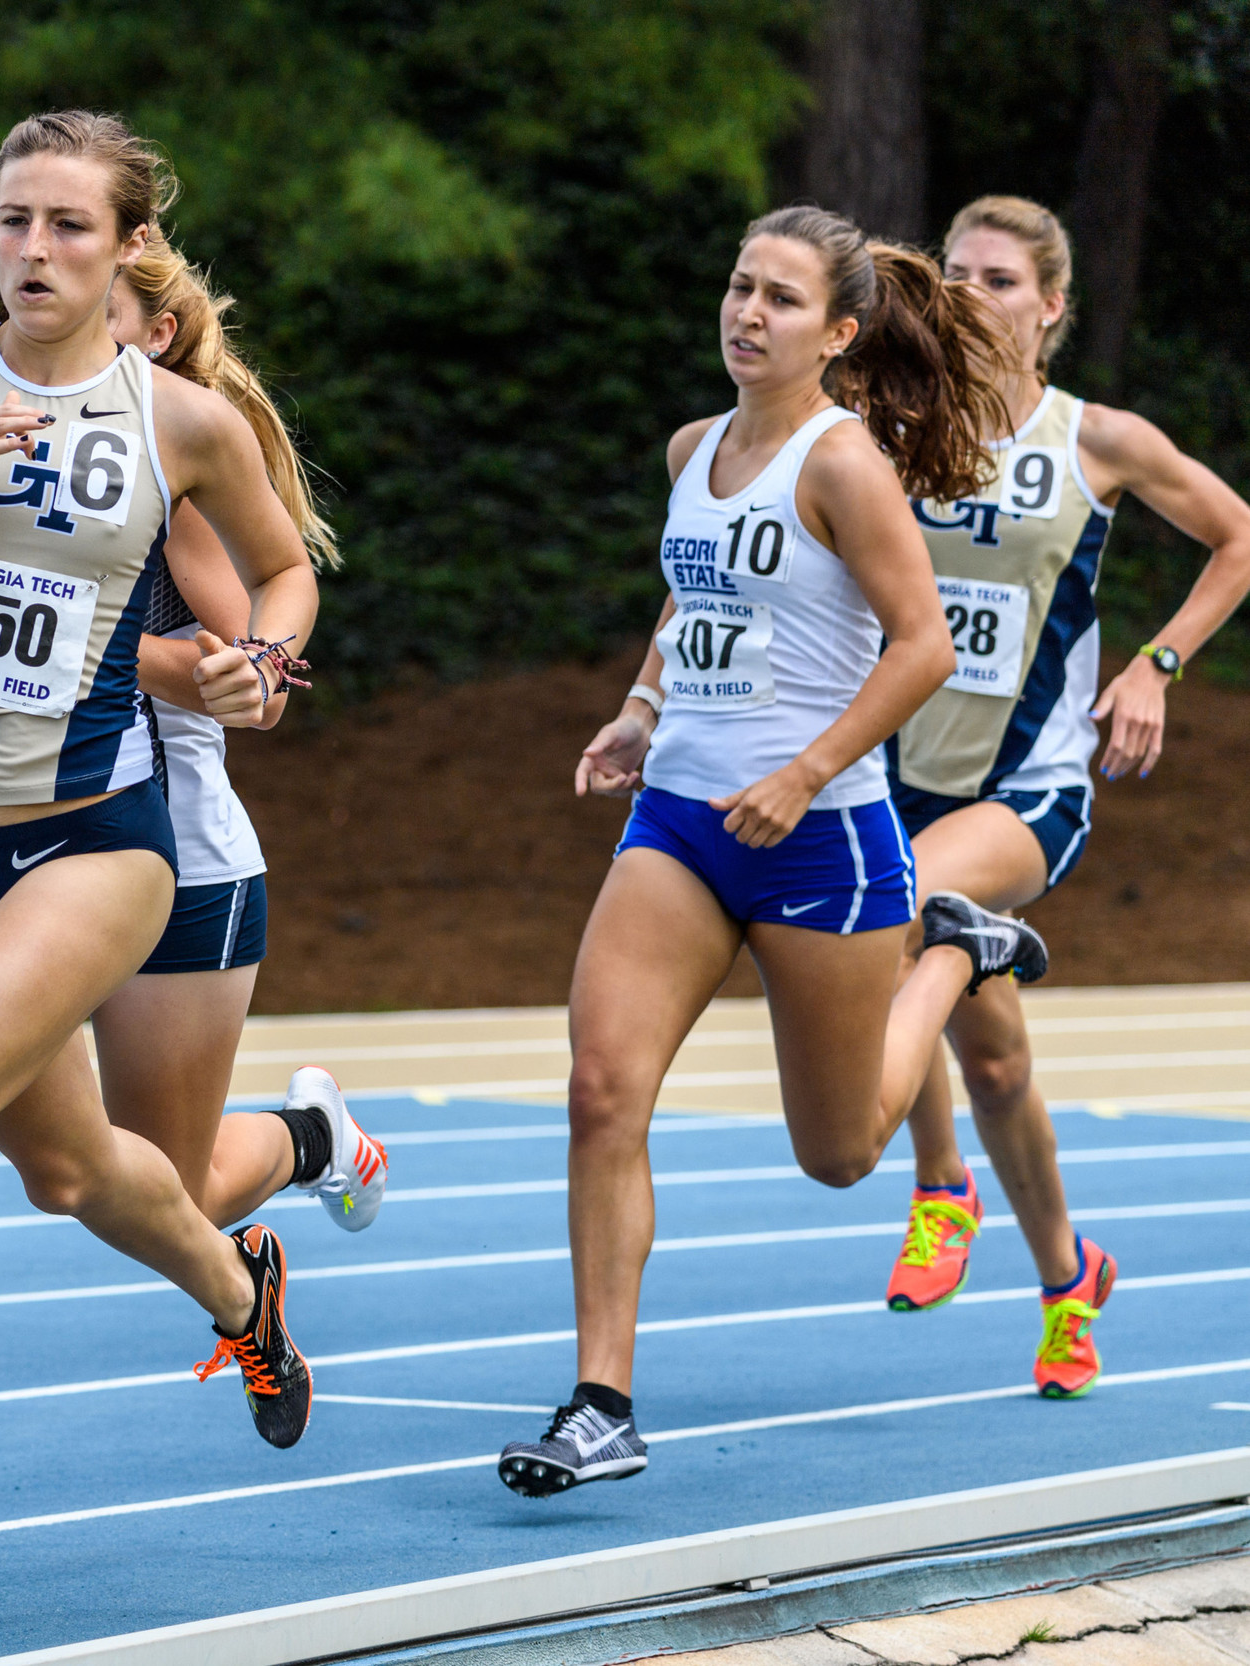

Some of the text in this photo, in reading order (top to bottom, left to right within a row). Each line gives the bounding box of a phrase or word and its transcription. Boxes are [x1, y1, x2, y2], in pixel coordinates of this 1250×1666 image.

[70, 430, 128, 511] 6
[1011, 453, 1055, 509] 9
[727, 514, 784, 576] 10
[31, 576, 76, 600] TECH
[673, 563, 736, 589] STATE
[977, 588, 1011, 603] TECH
[720, 602, 753, 618] TECH
[676, 619, 747, 671] 107
[963, 666, 998, 681] FIELD
[3, 677, 50, 700] FIELD
[672, 681, 753, 696] TRACK & FIELD
